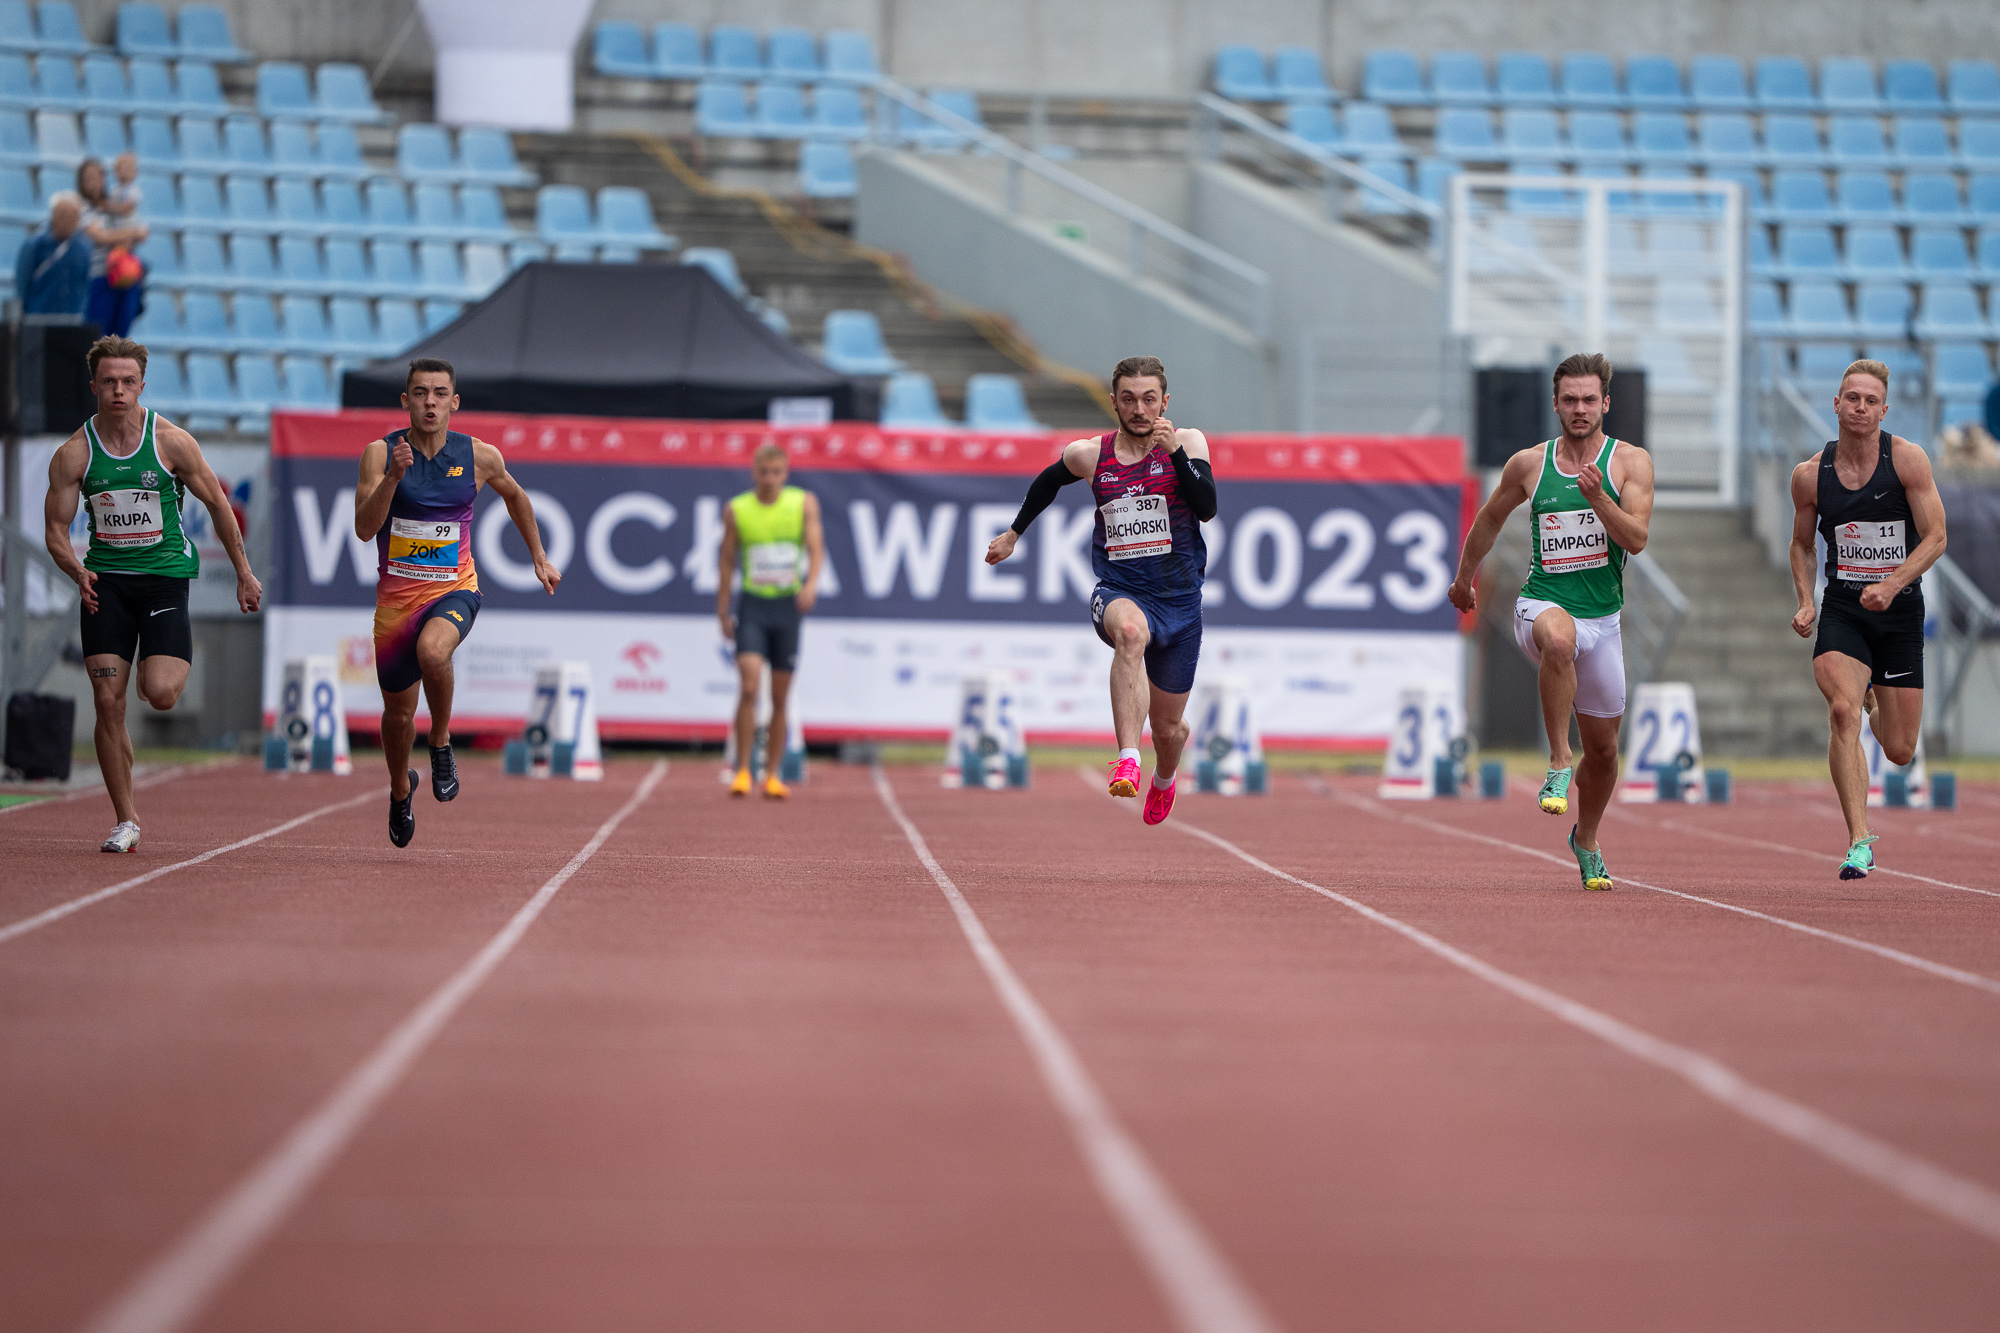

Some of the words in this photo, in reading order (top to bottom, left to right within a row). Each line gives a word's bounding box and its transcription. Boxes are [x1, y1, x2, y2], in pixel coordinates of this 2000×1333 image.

[132, 491, 150, 504] 74
[1135, 498, 1160, 512] 387
[1103, 507, 1129, 515] SUUNTO
[103, 512, 152, 527] KRUPA
[1577, 512, 1595, 526] 75
[435, 525, 451, 537] 99
[1107, 519, 1167, 539] BACHÓRSKI
[1879, 525, 1895, 538] 11
[1542, 532, 1606, 553] LEMPACH
[409, 542, 440, 559] ŻOK
[1839, 545, 1904, 561] ŁUKOMSKI
[1396, 704, 1423, 769] 3
[1635, 708, 1661, 772] 2
